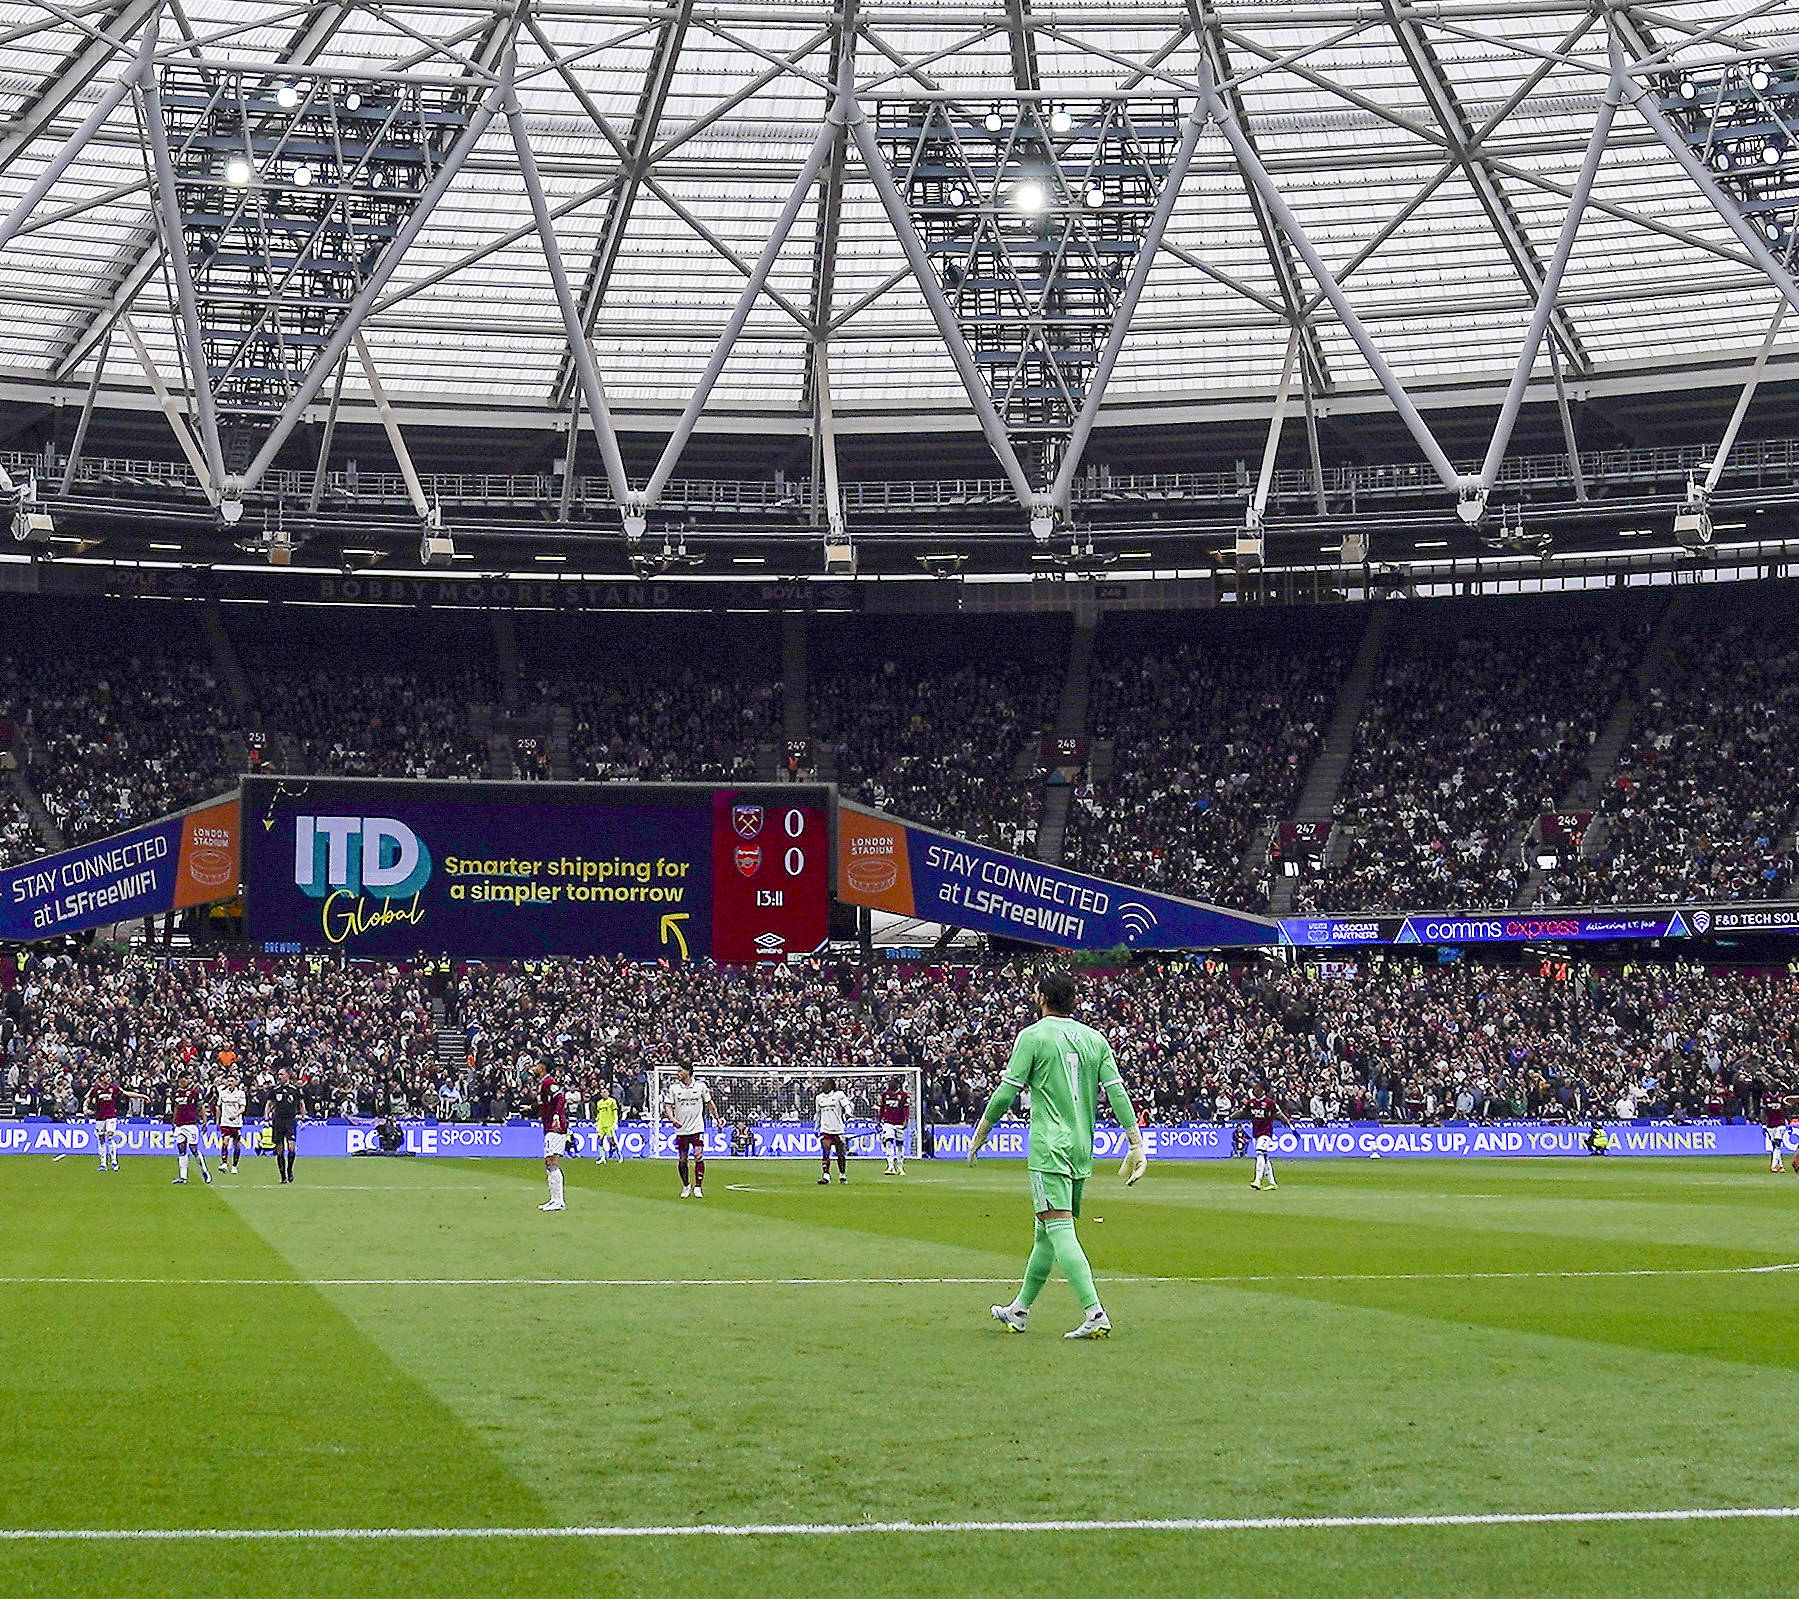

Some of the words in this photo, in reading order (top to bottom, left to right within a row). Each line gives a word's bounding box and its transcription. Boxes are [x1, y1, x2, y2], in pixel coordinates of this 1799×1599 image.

[320, 580, 422, 599] BOBBY
[439, 582, 554, 601] MOORE
[564, 585, 671, 604] STAND
[249, 733, 266, 742] 251
[787, 741, 806, 750] 249
[1057, 740, 1076, 748] 248
[784, 809, 805, 838] 0
[1296, 824, 1316, 834] 247
[1557, 816, 1578, 826] 246
[193, 828, 229, 839] LONDON
[193, 838, 229, 847] STADIUM
[851, 837, 894, 846] LONDON
[295, 815, 425, 892] ITD
[851, 846, 894, 855] STADIUM
[12, 872, 58, 904] STAY
[61, 835, 168, 887] CONNECTED
[445, 856, 542, 876] Smarter
[548, 857, 651, 882] shipping
[656, 857, 690, 877] for
[784, 847, 805, 876] 0
[926, 845, 979, 877] STAY
[981, 861, 1109, 915] CONNECTED
[33, 903, 53, 929] at
[55, 868, 158, 922] LSFreeWIFI
[450, 884, 465, 899] a
[471, 880, 561, 906] simpler
[566, 883, 684, 902] tomorrow
[757, 890, 783, 906] 13:11
[323, 888, 426, 943] Global
[938, 882, 959, 904] at
[963, 888, 1085, 941] LSFreeWIFI
[1715, 913, 1737, 925] F&D
[1740, 912, 1771, 925] TECH
[1332, 923, 1379, 932] ASSOCIATE
[1332, 931, 1378, 939] PARTNERS
[1425, 921, 1502, 939] comms
[1506, 921, 1579, 939] express
[1066, 1053, 1080, 1101] 1
[35, 1129, 89, 1148] AND
[347, 1130, 437, 1153] BOLE
[441, 1130, 502, 1146] SPORTS
[1161, 1131, 1218, 1147] SPORTS
[1300, 1133, 1354, 1151] TWO
[1359, 1132, 1434, 1152] GOALS
[1438, 1132, 1470, 1155] UP,
[1473, 1132, 1523, 1151] AND
[1527, 1132, 1588, 1151] YOU'R
[1627, 1131, 1716, 1150] WINNER
